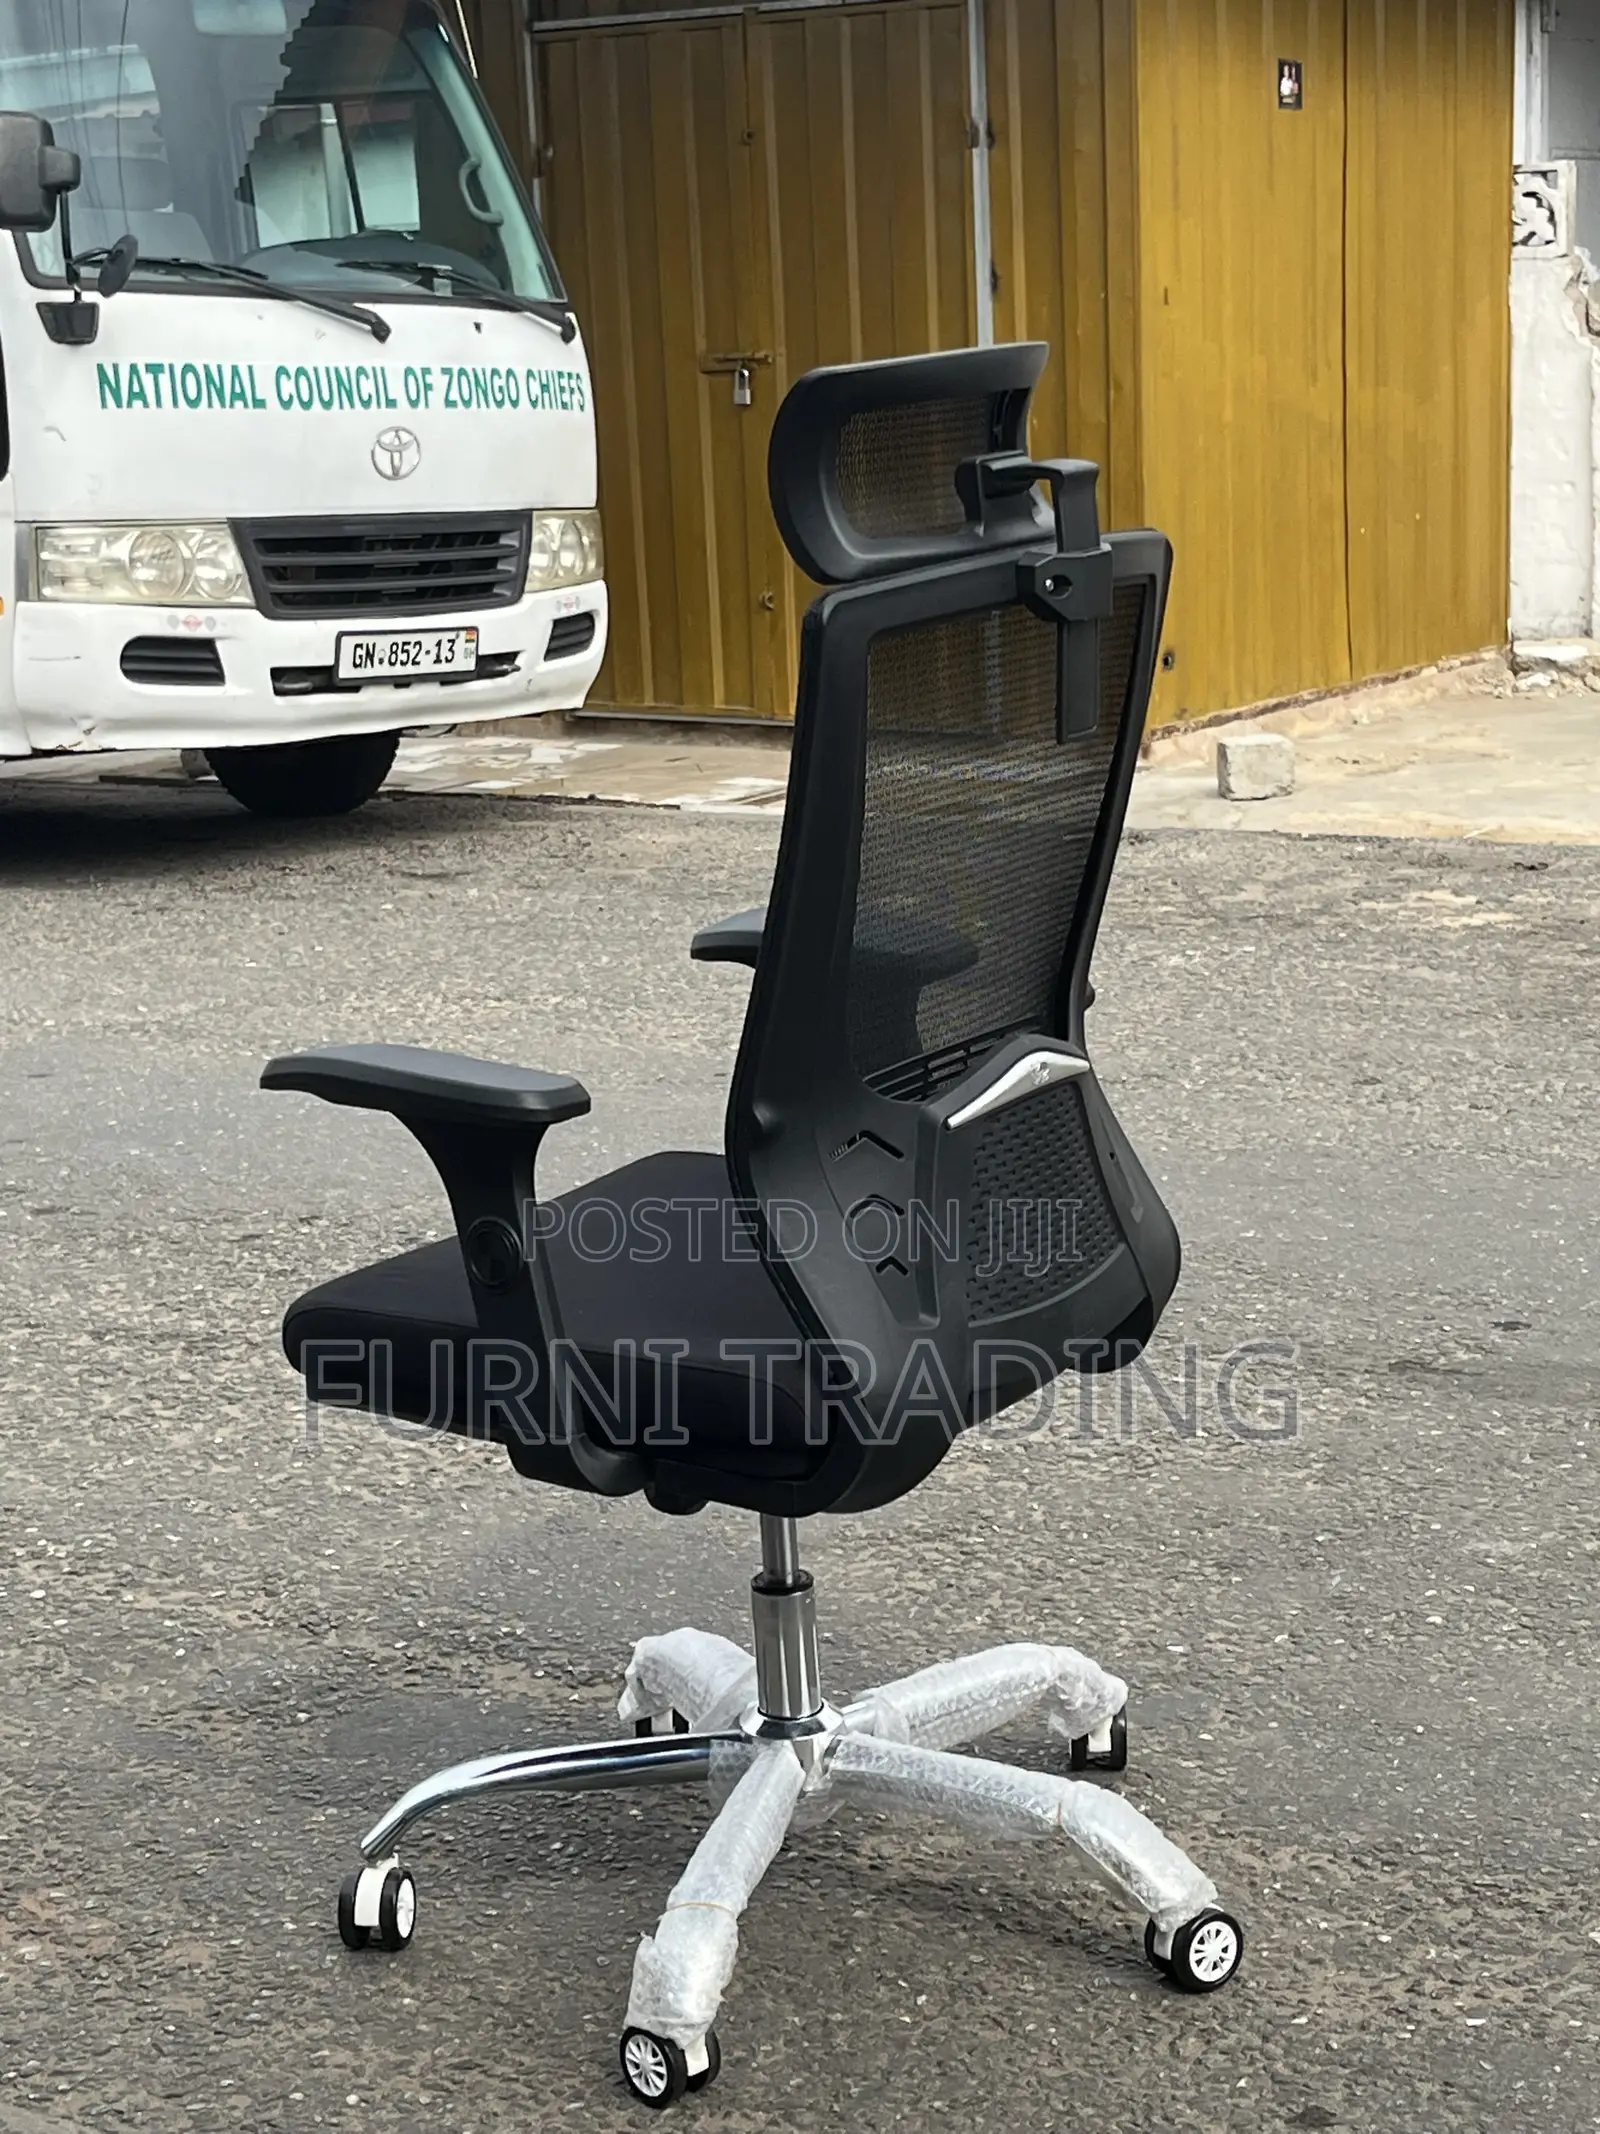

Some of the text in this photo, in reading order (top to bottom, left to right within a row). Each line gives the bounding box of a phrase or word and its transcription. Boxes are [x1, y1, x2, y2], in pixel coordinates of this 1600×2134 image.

[96, 362, 586, 412] NATIONAL COUNCIL OF ZONGO CHIEFS
